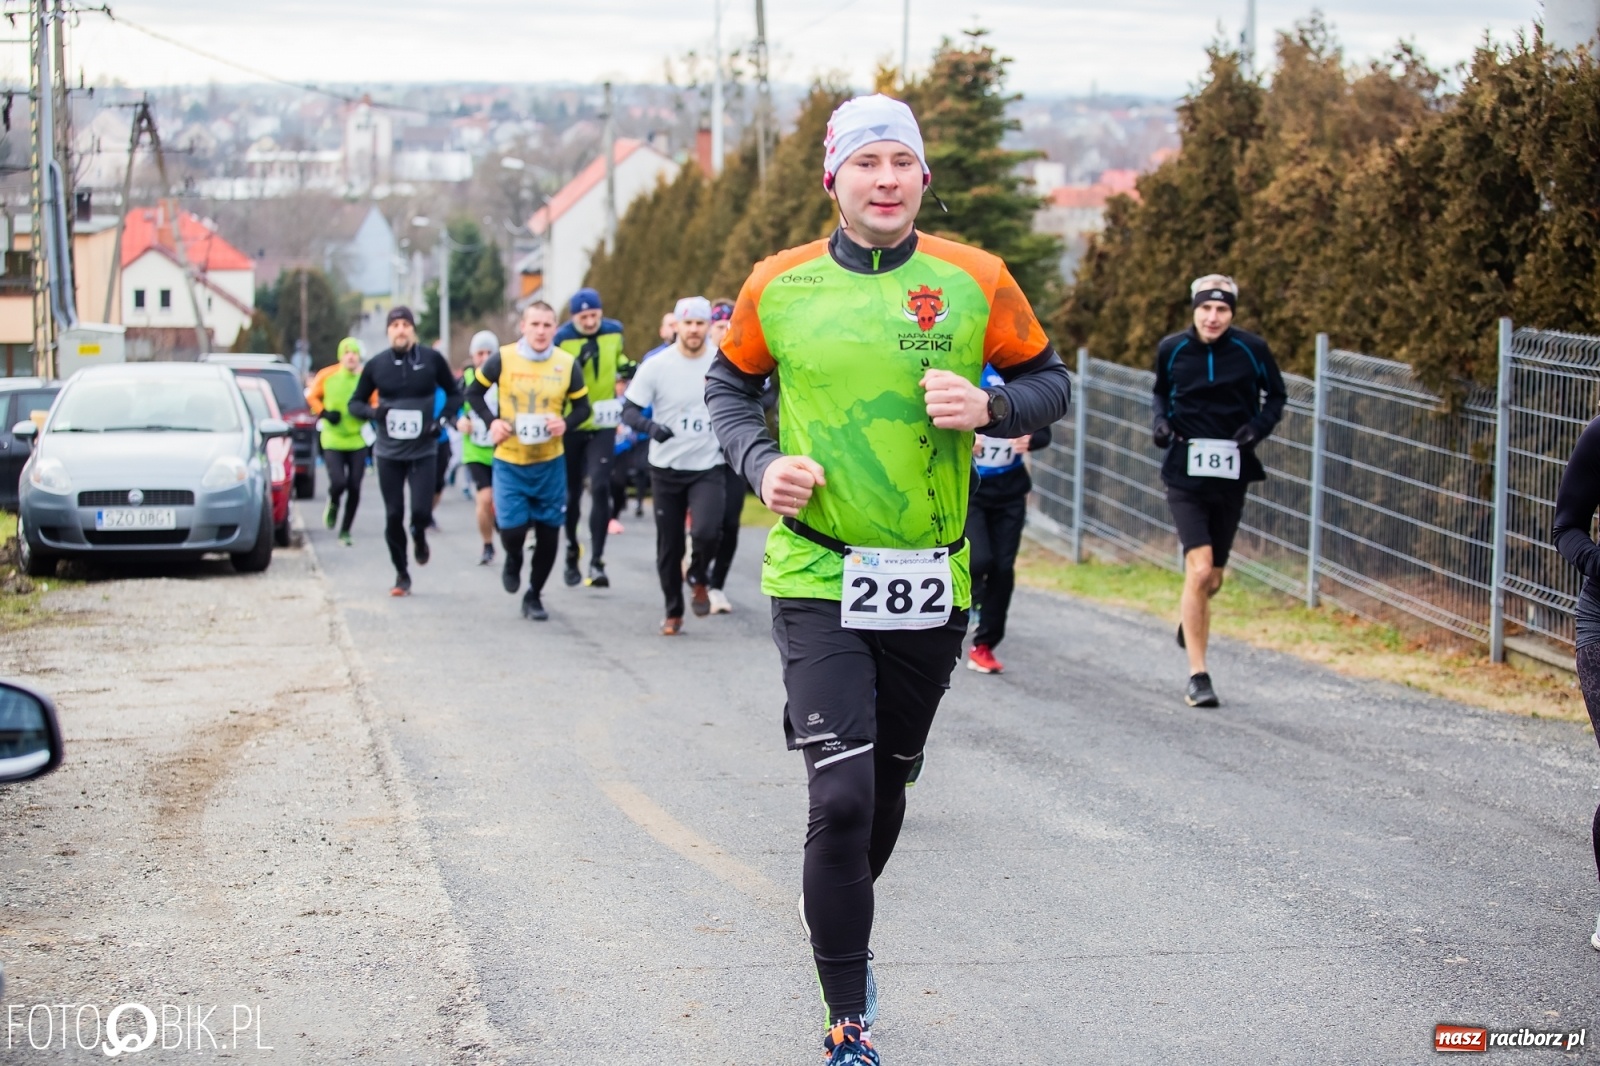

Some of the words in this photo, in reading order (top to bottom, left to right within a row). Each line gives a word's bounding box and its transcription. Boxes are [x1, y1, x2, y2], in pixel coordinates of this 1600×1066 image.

[782, 274, 823, 285] deep
[900, 339, 952, 351] DZIKI
[389, 420, 418, 433] 243
[681, 418, 713, 432] 161
[1194, 453, 1234, 471] 181
[849, 576, 946, 615] 282
